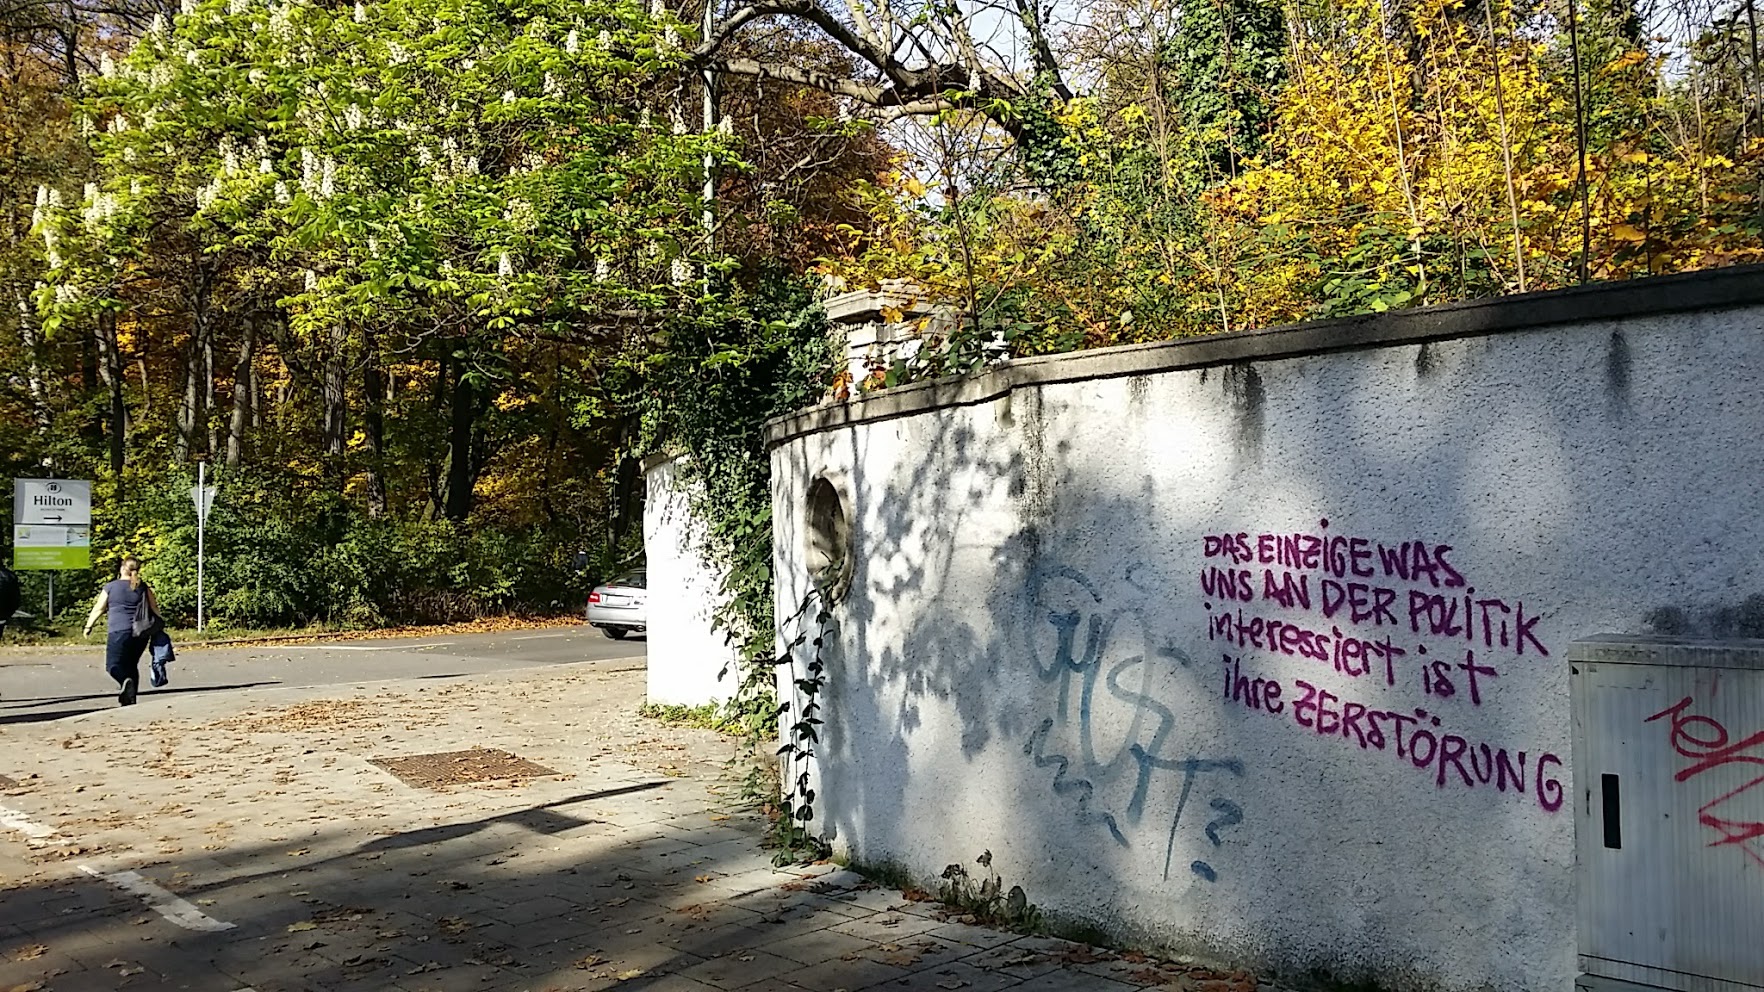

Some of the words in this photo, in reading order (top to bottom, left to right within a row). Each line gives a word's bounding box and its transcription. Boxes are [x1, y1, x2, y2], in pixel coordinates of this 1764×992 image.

[33, 495, 72, 506] Hilton
[1203, 532, 1251, 564] DAS
[1377, 541, 1466, 588] WAS
[1200, 567, 1253, 600] UNS
[1263, 569, 1311, 610] AN
[1321, 579, 1398, 626] DER
[1204, 602, 1405, 686] interessiert
[1418, 644, 1499, 706] ist
[1222, 654, 1284, 713] ihre
[1292, 679, 1564, 813] ZERSTÖRUNG
